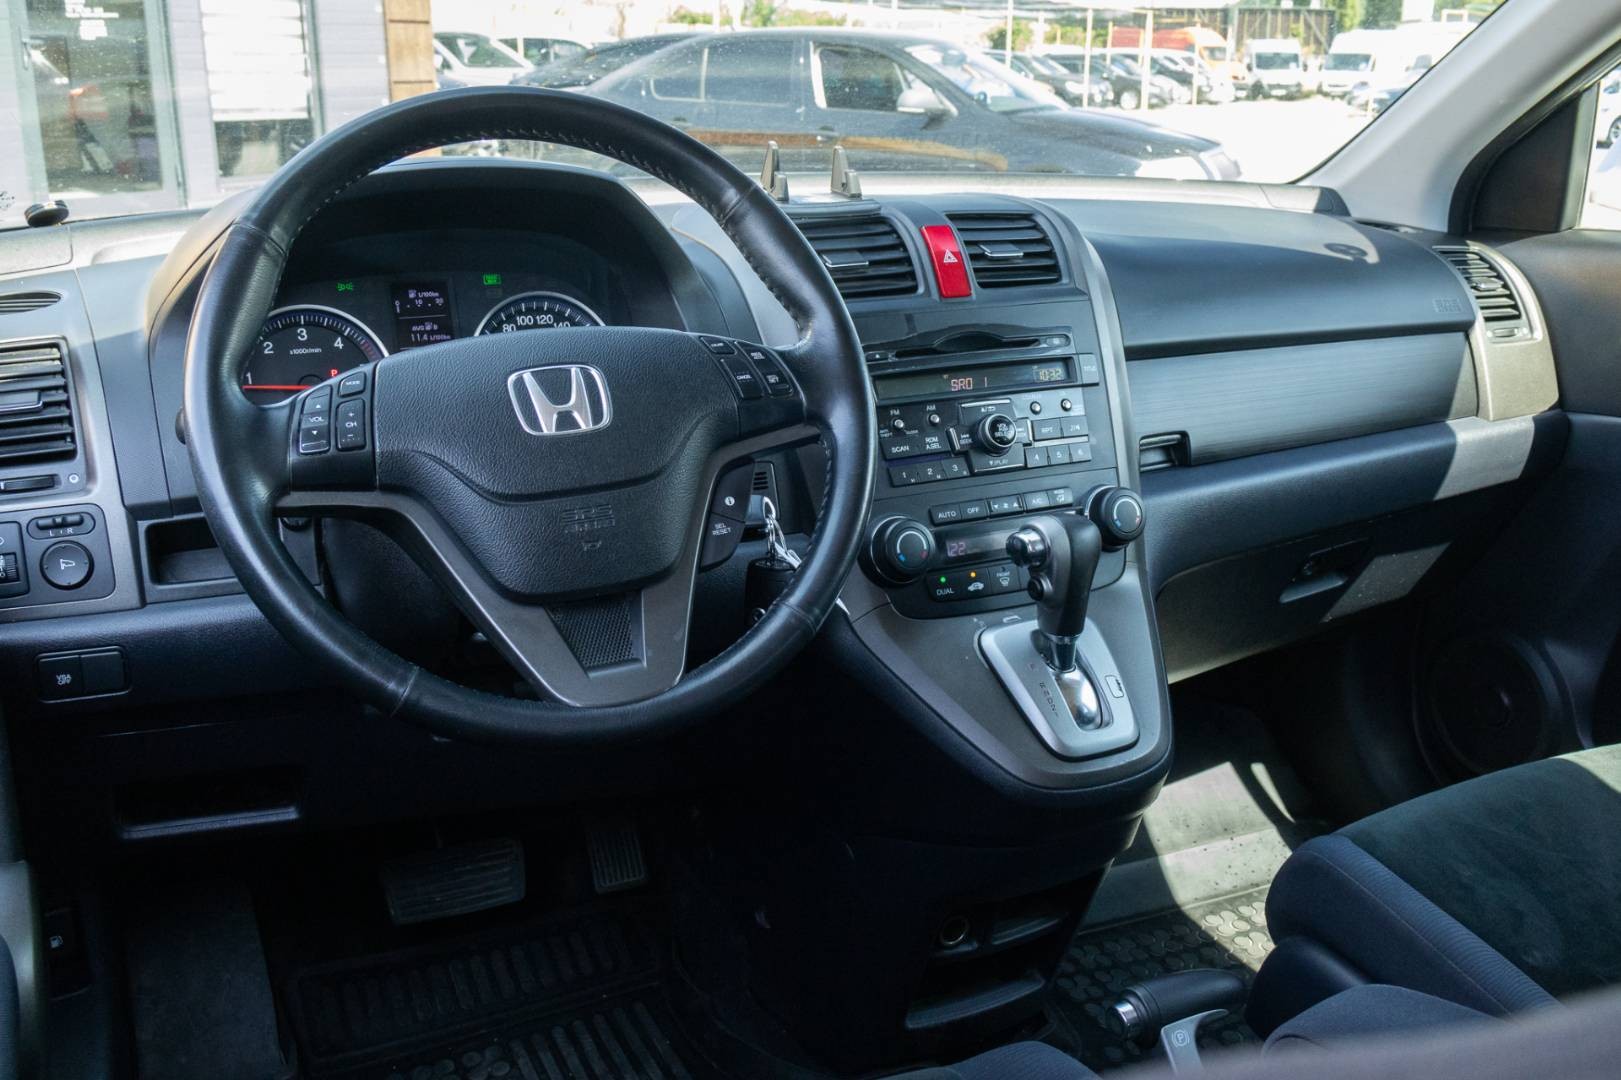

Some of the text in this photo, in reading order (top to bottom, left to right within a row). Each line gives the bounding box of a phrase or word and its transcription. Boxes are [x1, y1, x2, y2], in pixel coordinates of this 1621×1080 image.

[502, 324, 517, 333] 80
[516, 315, 534, 326] 100
[535, 314, 554, 325] 120
[245, 328, 344, 385] 1 2 3 4
[330, 369, 338, 377] P
[891, 445, 910, 454] SCAN
[926, 467, 934, 475] 2
[937, 506, 980, 519] AUTO OFF
[936, 586, 955, 596] DUAL
